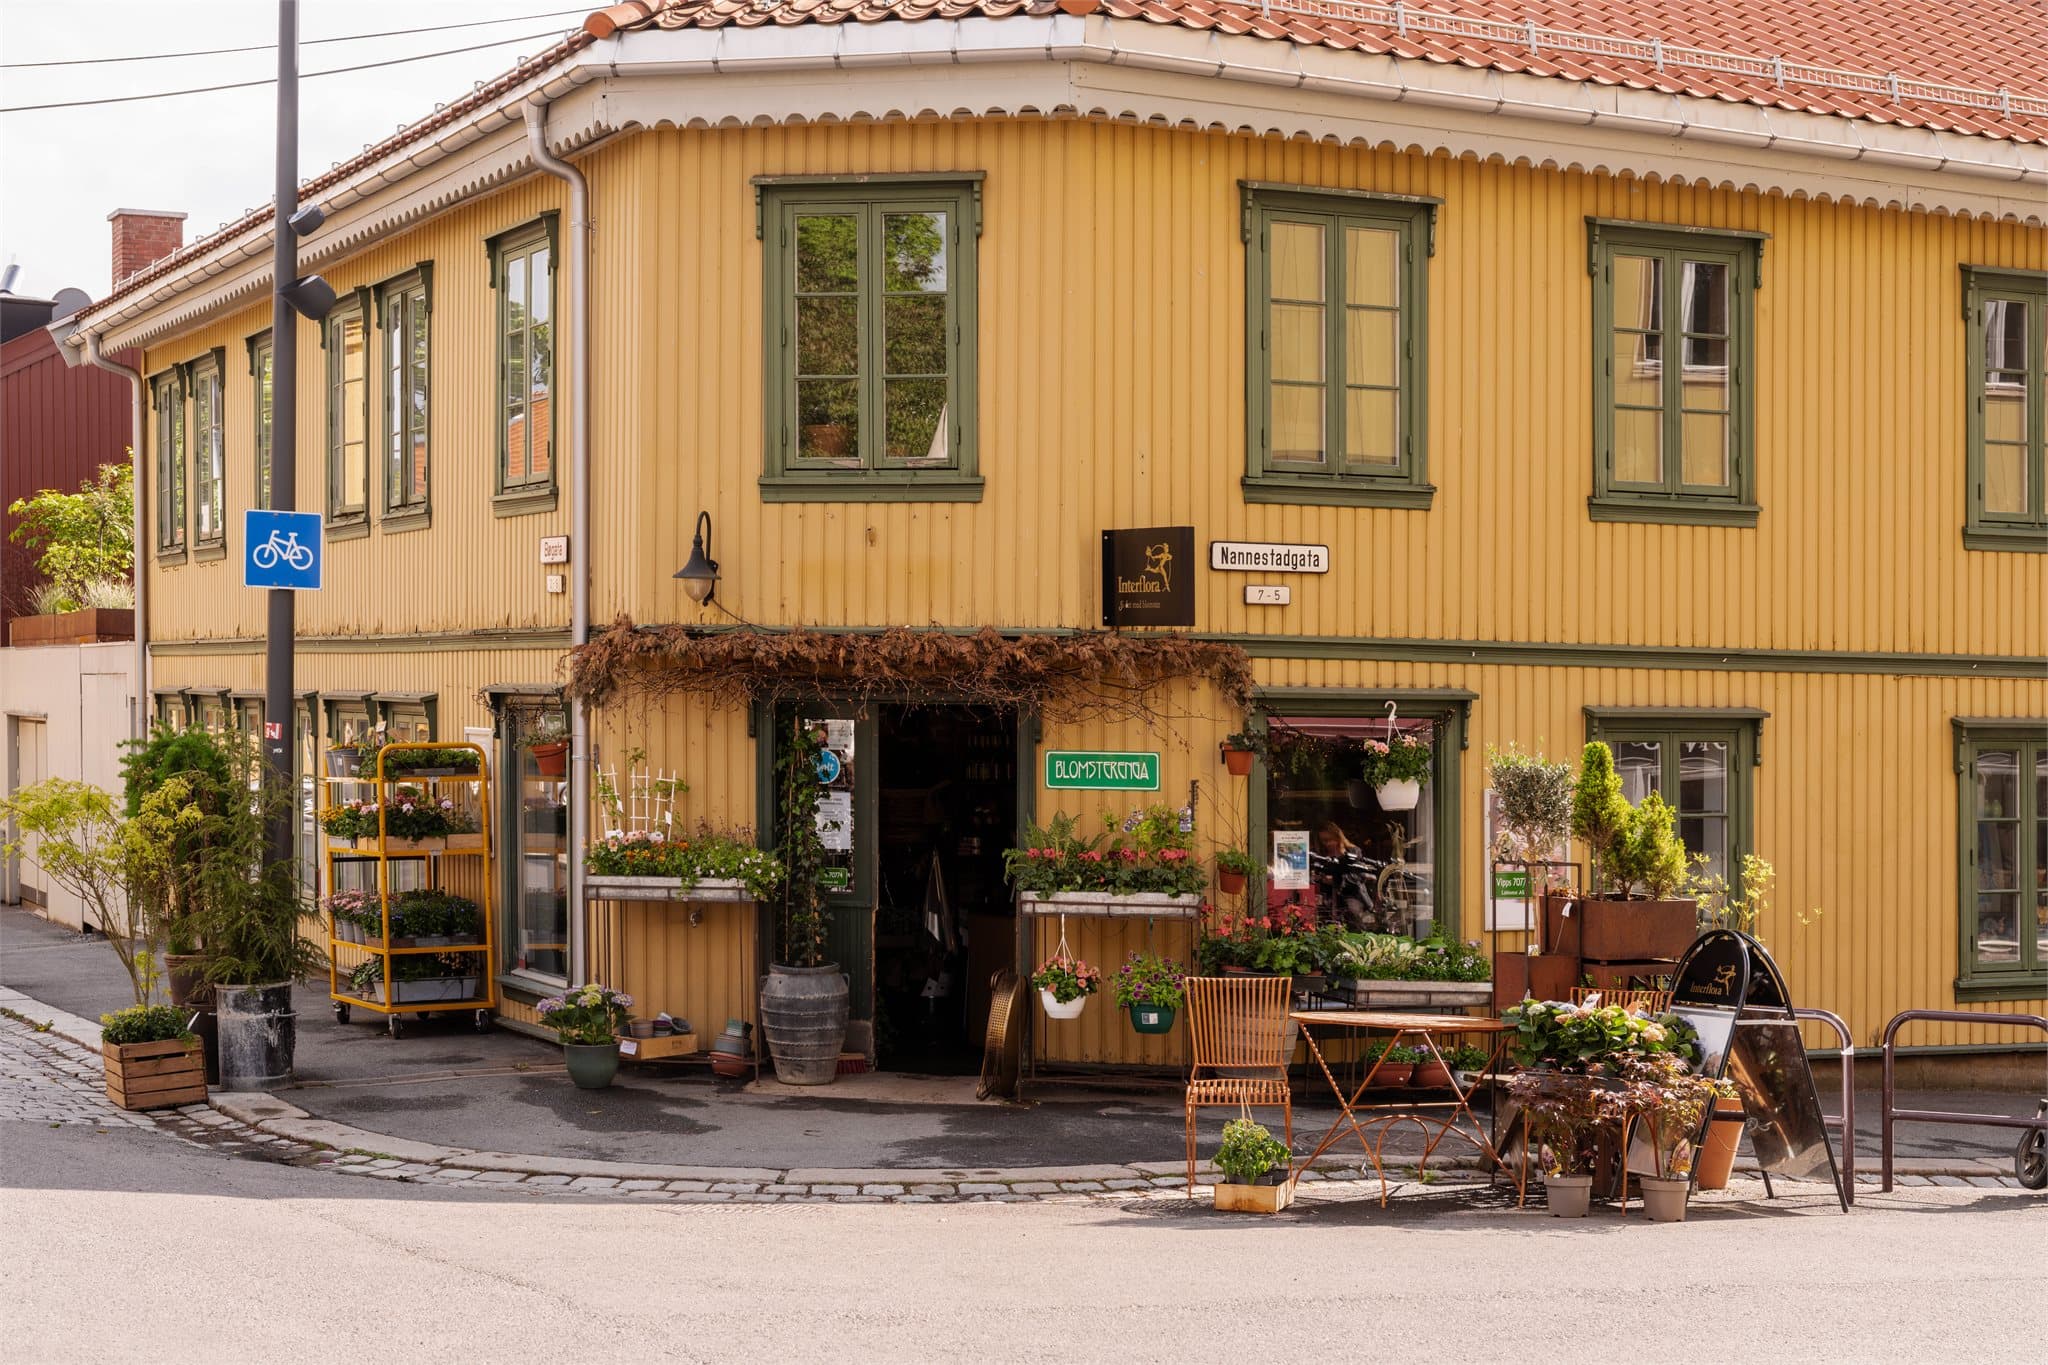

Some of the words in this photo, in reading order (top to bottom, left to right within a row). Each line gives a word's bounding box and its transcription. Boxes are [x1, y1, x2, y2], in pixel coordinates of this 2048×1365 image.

[1221, 546, 1320, 570] Nannestadgata
[1118, 575, 1161, 593] Interflora
[1055, 760, 1150, 780] BLOMSTERENGA
[1496, 877, 1512, 888] Vipps
[1690, 982, 1723, 996] Interflora
